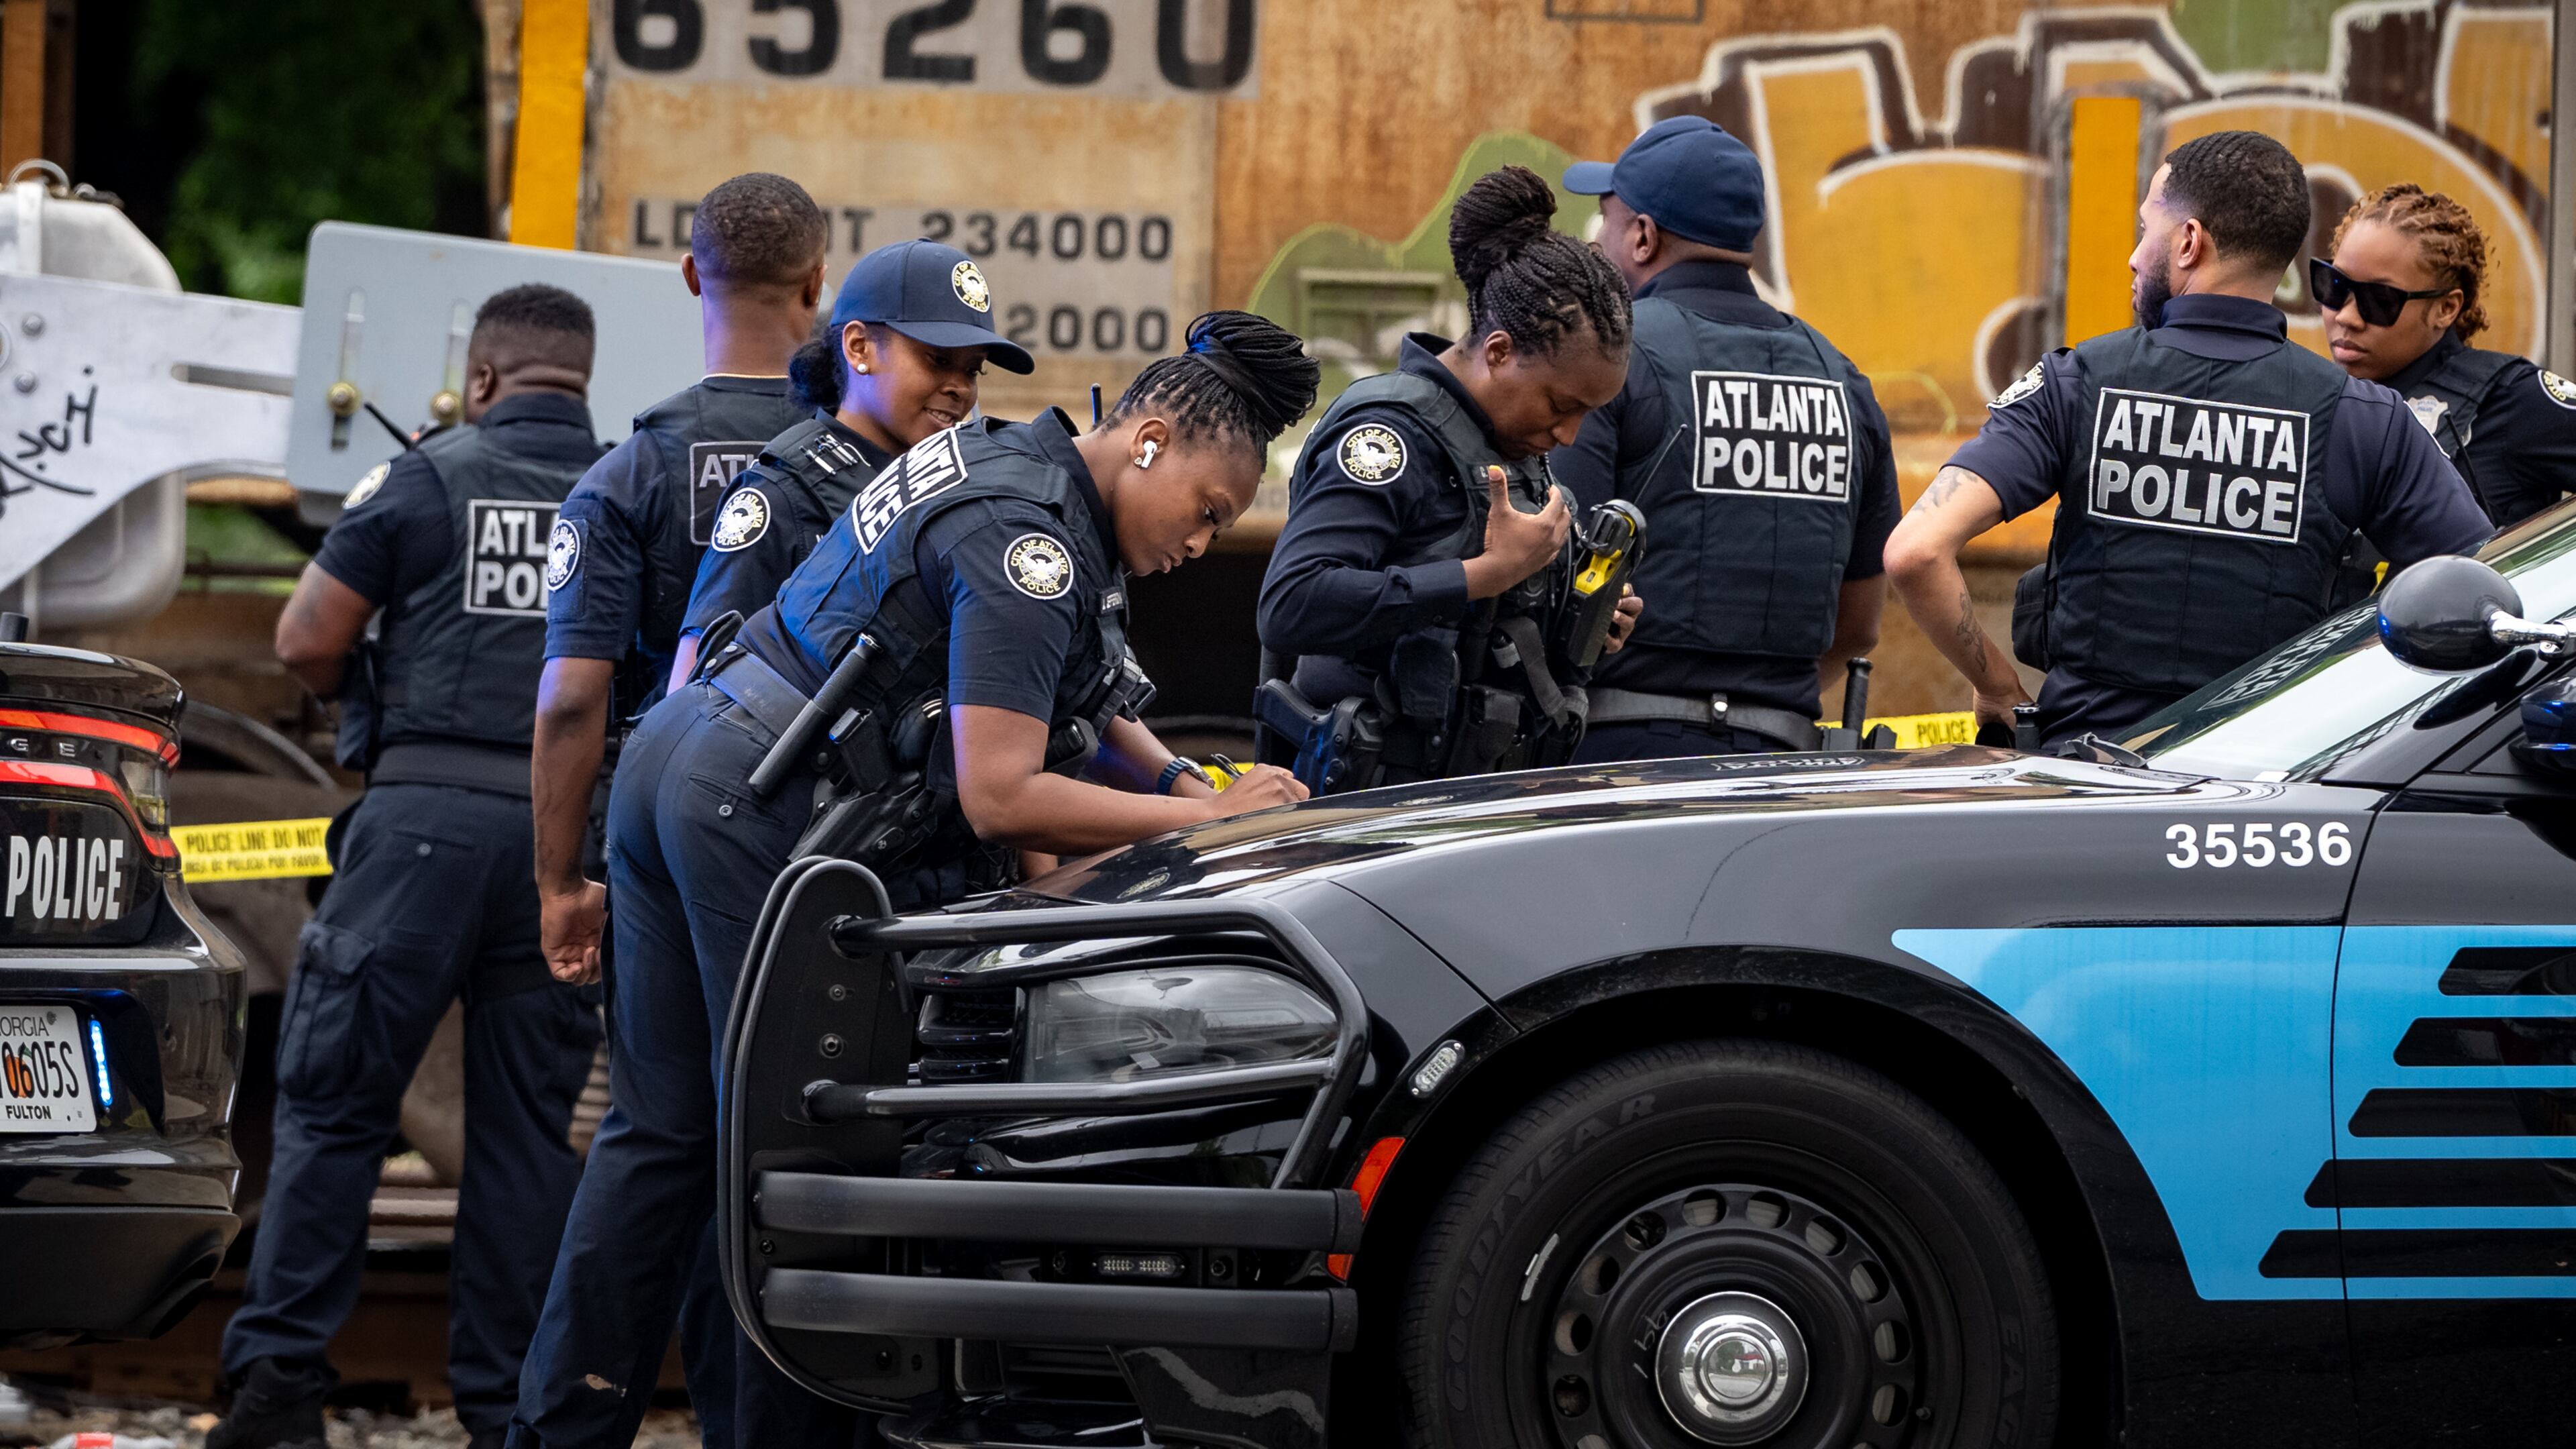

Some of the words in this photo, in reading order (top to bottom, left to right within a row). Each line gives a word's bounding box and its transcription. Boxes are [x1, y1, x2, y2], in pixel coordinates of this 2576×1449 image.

[922, 210, 1172, 261] 234000
[1705, 380, 1845, 437] ATLANTA
[1346, 431, 1363, 447] CITY
[1381, 433, 1401, 468] ATLANTA
[2102, 398, 2297, 474] ATLANTA
[1344, 458, 1383, 480] POLICE
[1703, 437, 1846, 494] POLICE
[2097, 459, 2297, 535] POLICE
[478, 510, 560, 557] ATL
[1010, 547, 1023, 567] CITY
[1022, 539, 1037, 549] OF
[1038, 540, 1069, 574] ATLANTA
[1018, 577, 1061, 594] POLICE
[1917, 719, 1969, 744] POLICE
[186, 833, 231, 853] POLICE
[239, 830, 266, 851] LINE
[274, 828, 291, 848] DO
[297, 826, 323, 847] NOT
[2165, 822, 2352, 868] 35536
[5, 835, 123, 920] POLICE
[0, 1016, 50, 1036] ORGIA
[0, 1041, 79, 1098] 0605S
[5, 1106, 52, 1120] FULTON
[1446, 1093, 1656, 1412] GOODYEAR
